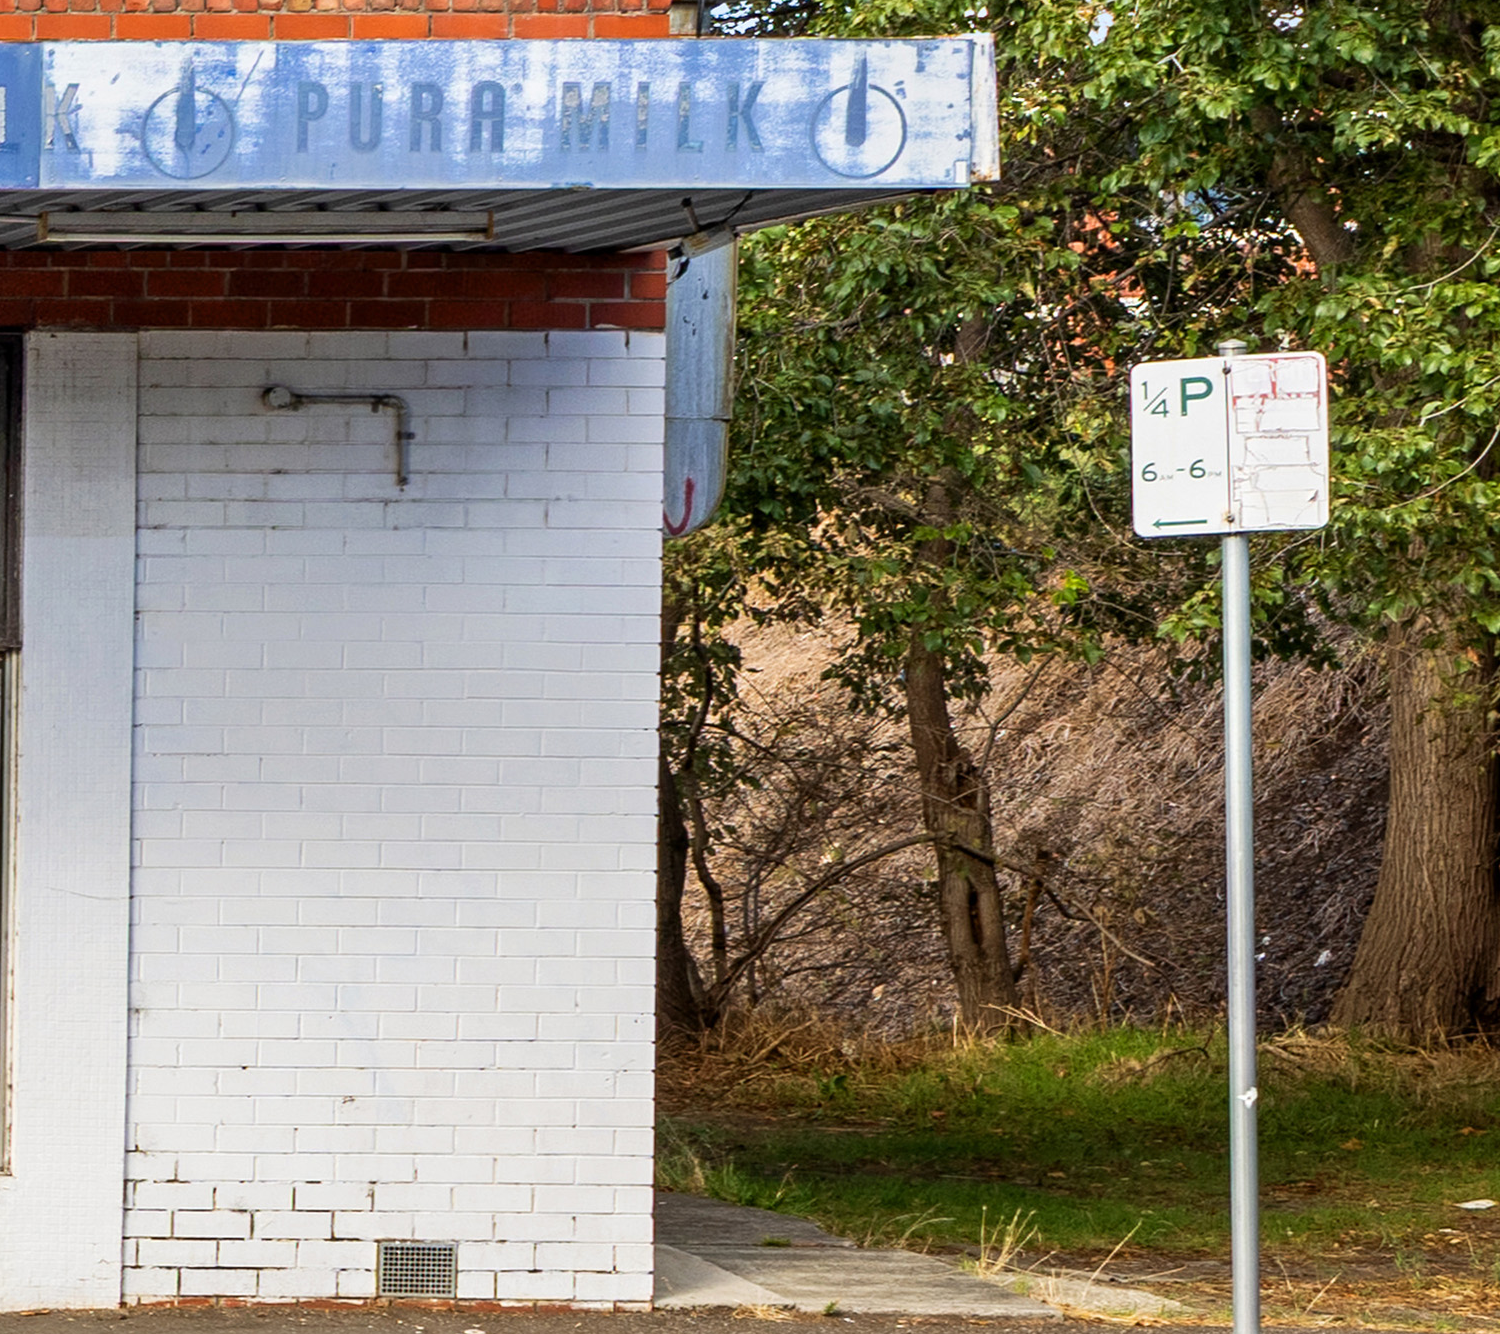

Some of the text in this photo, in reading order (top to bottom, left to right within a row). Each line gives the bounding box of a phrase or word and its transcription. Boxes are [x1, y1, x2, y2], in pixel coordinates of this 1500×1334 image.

[297, 80, 766, 154] PURA MILK
[1180, 376, 1214, 417] P
